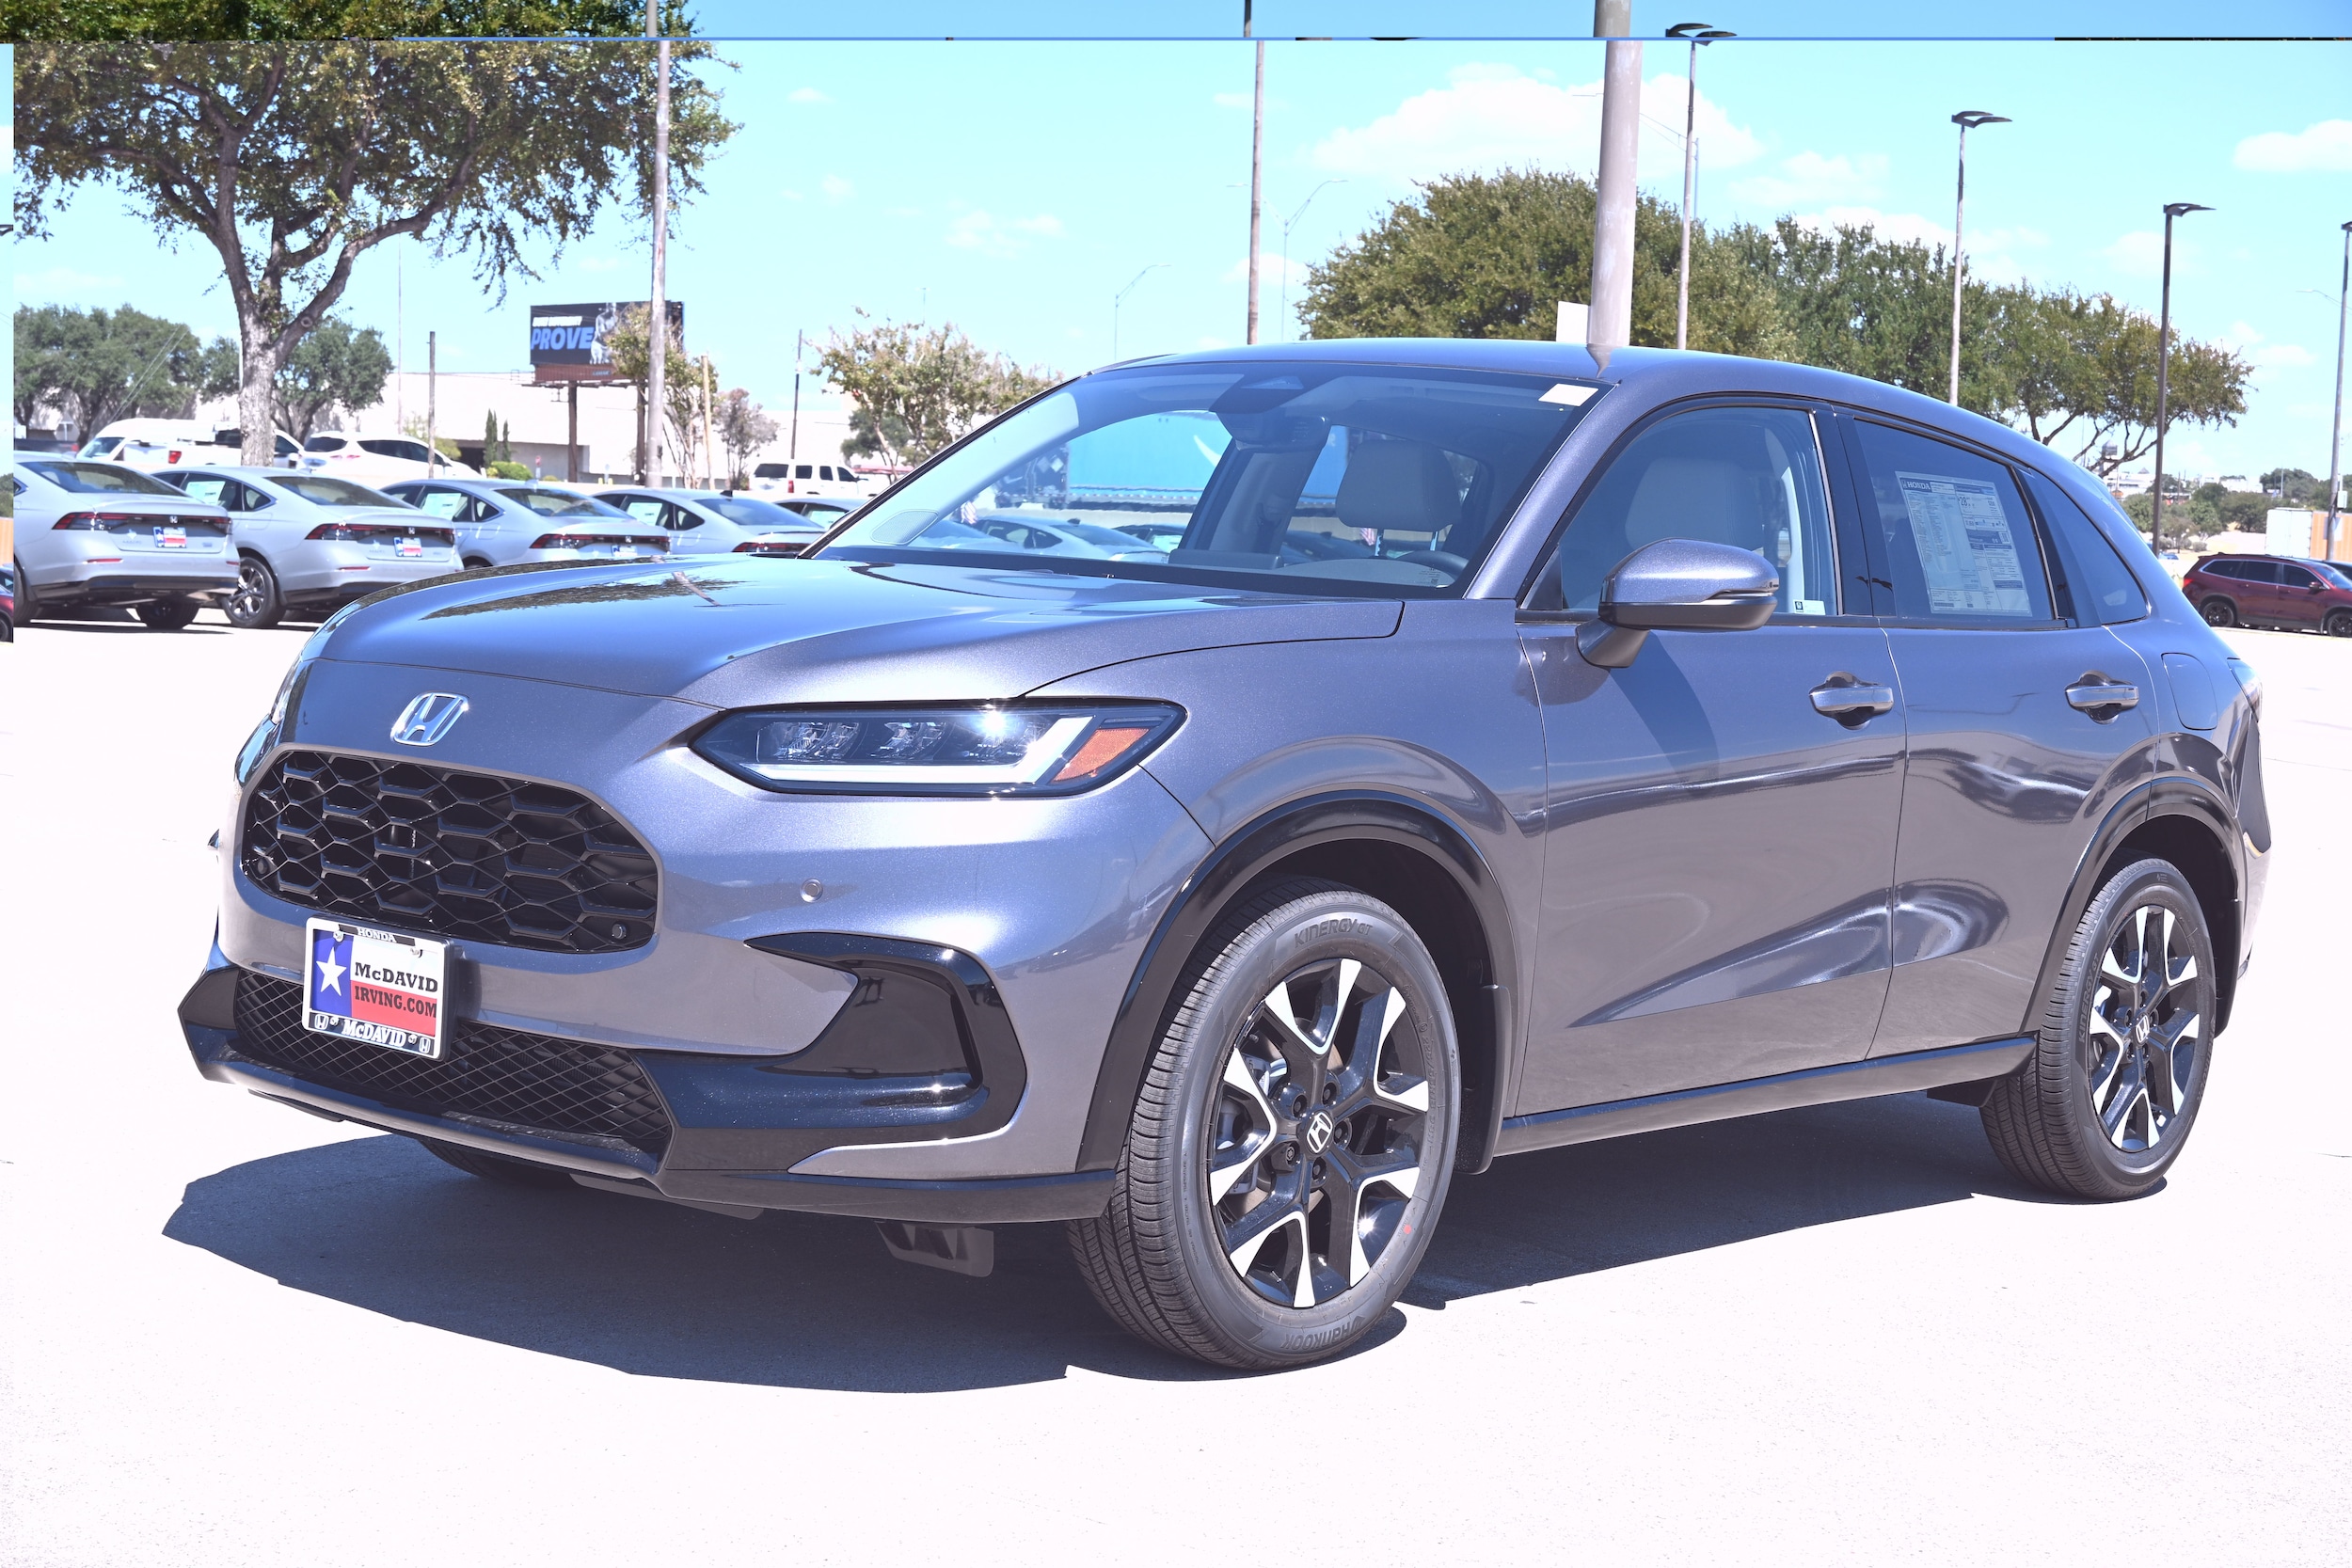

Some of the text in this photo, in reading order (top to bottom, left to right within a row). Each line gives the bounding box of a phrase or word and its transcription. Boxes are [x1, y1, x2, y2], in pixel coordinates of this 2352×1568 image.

[531, 327, 595, 350] PROVE
[1906, 481, 1931, 490] HONDA
[357, 927, 397, 943] HONDA
[1357, 923, 1374, 936] GT
[354, 961, 438, 993] McDAVID
[354, 985, 437, 1019] IRVING.COM
[341, 1019, 406, 1048] McDAVID
